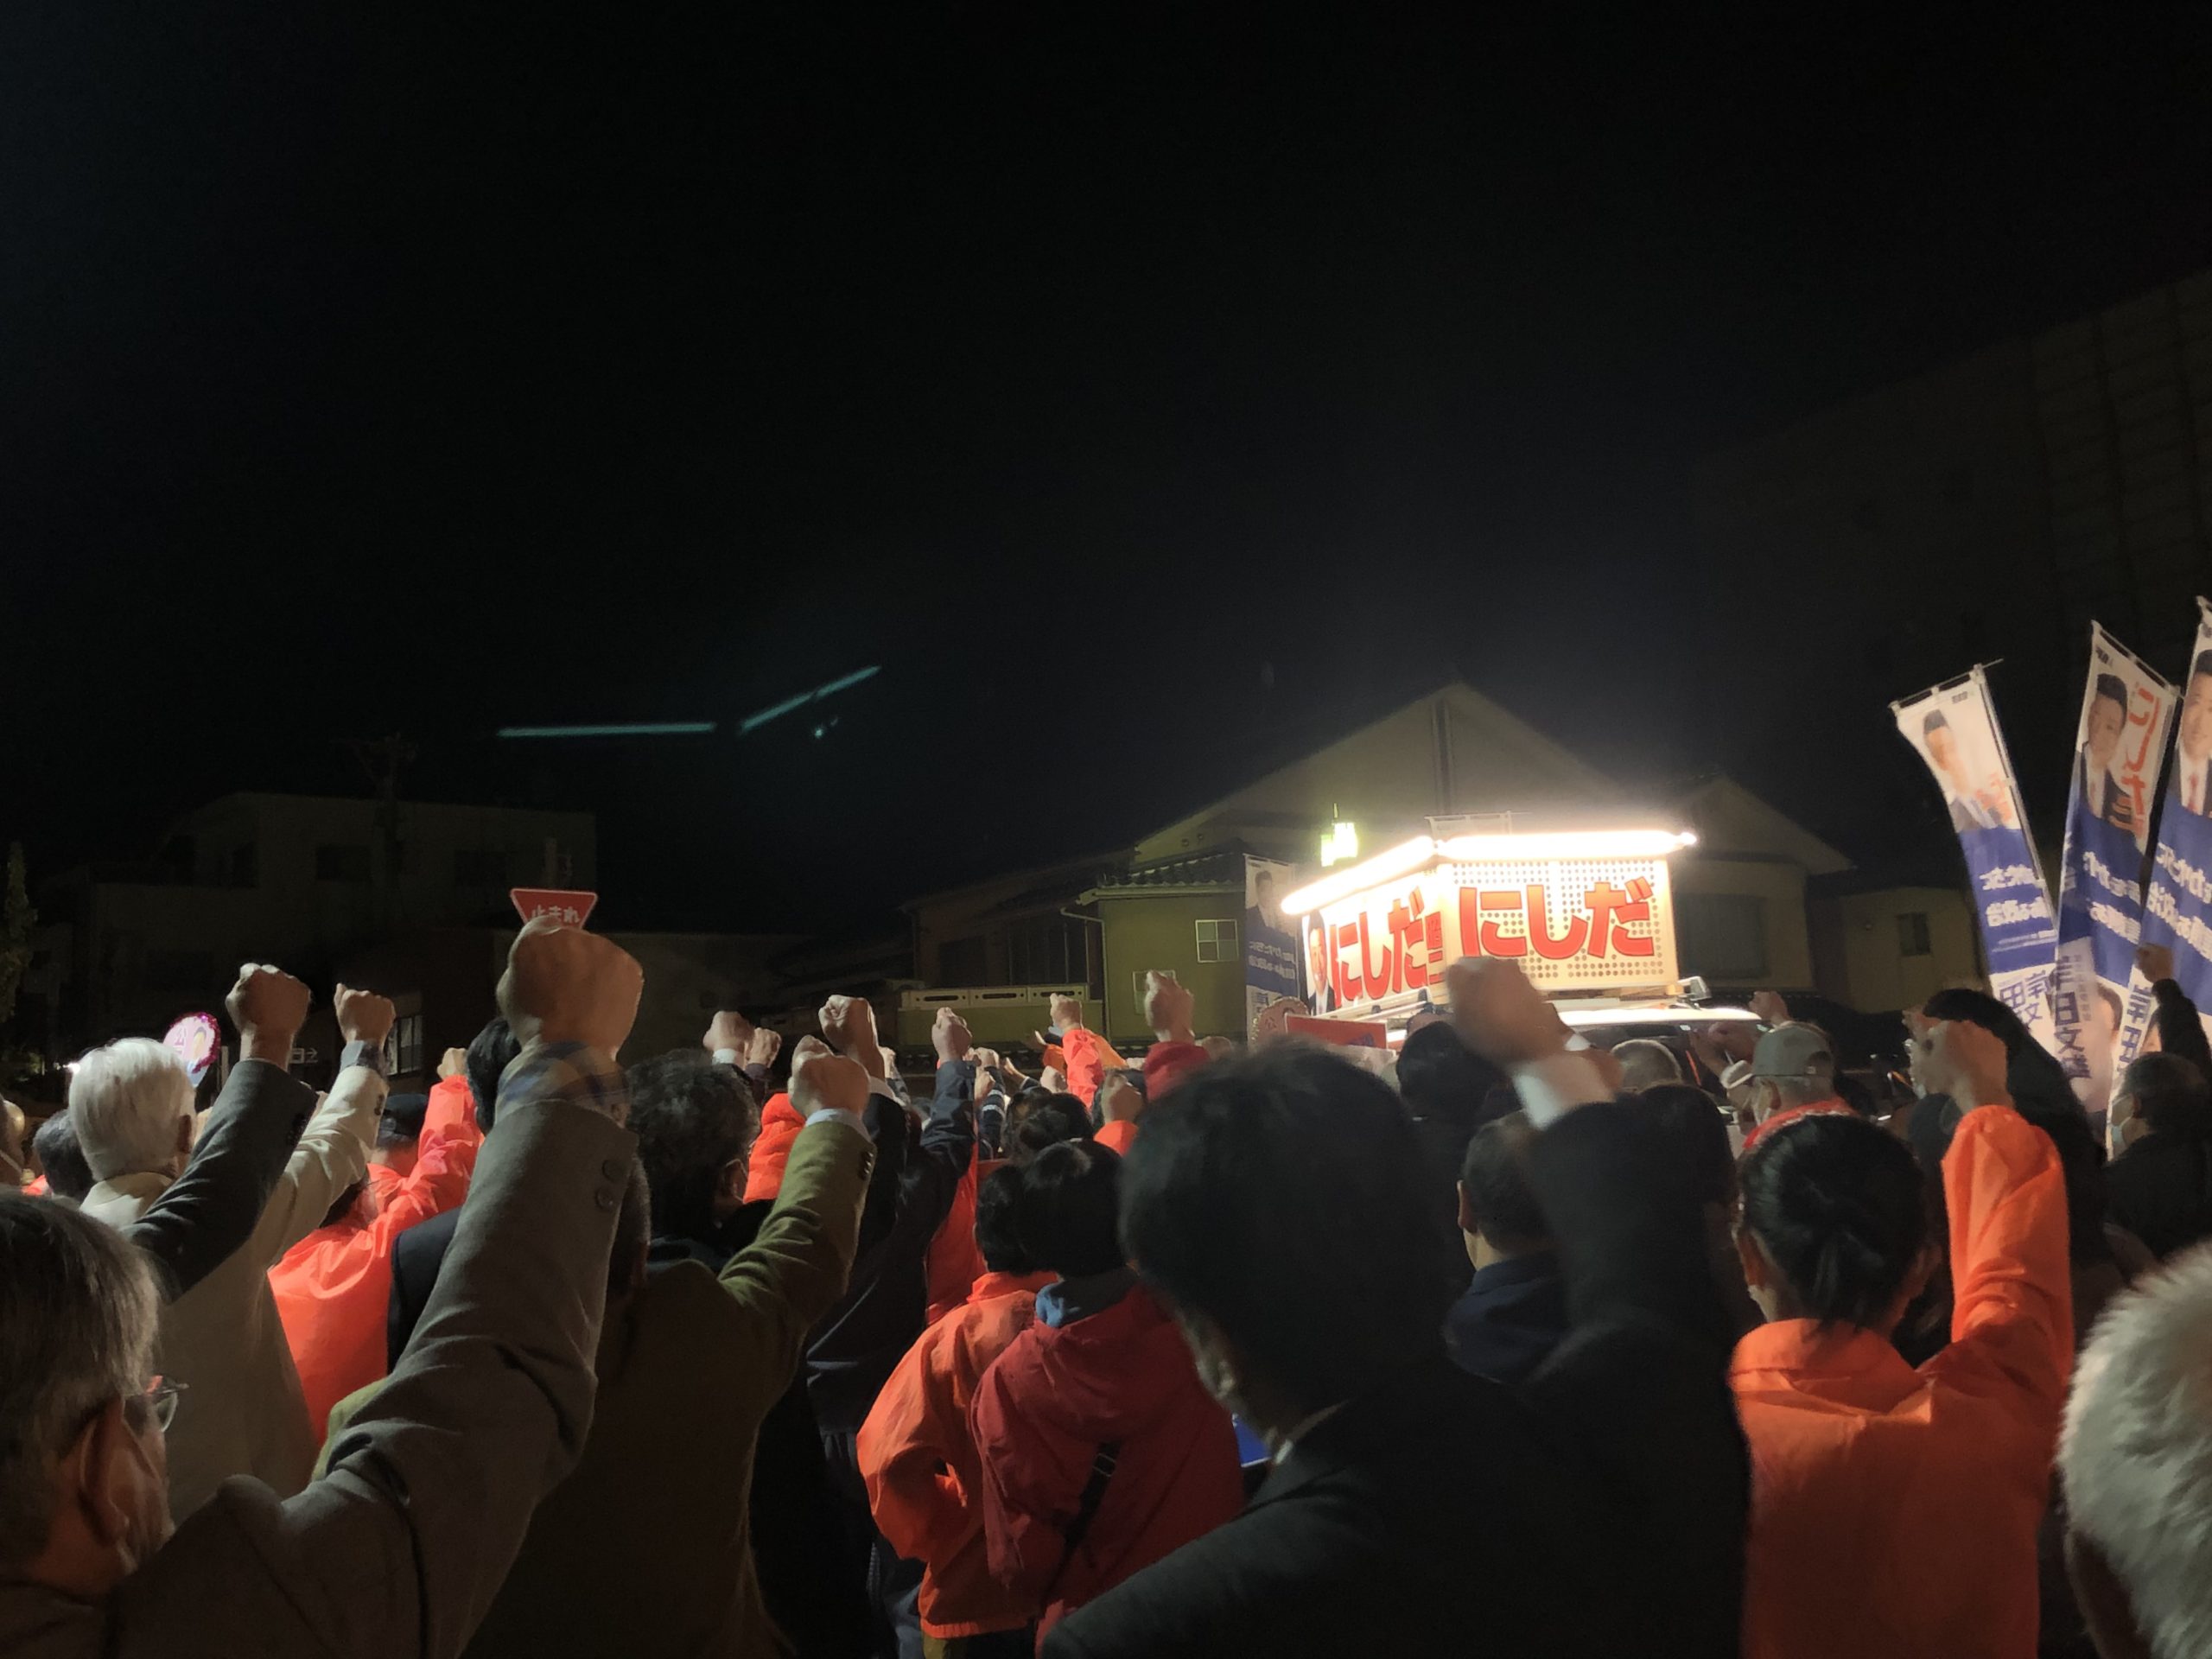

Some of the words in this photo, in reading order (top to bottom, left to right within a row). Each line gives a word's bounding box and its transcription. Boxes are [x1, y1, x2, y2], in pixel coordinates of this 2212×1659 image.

[1329, 885, 1427, 1009] にしだ
[1459, 875, 1655, 959] にしだ
